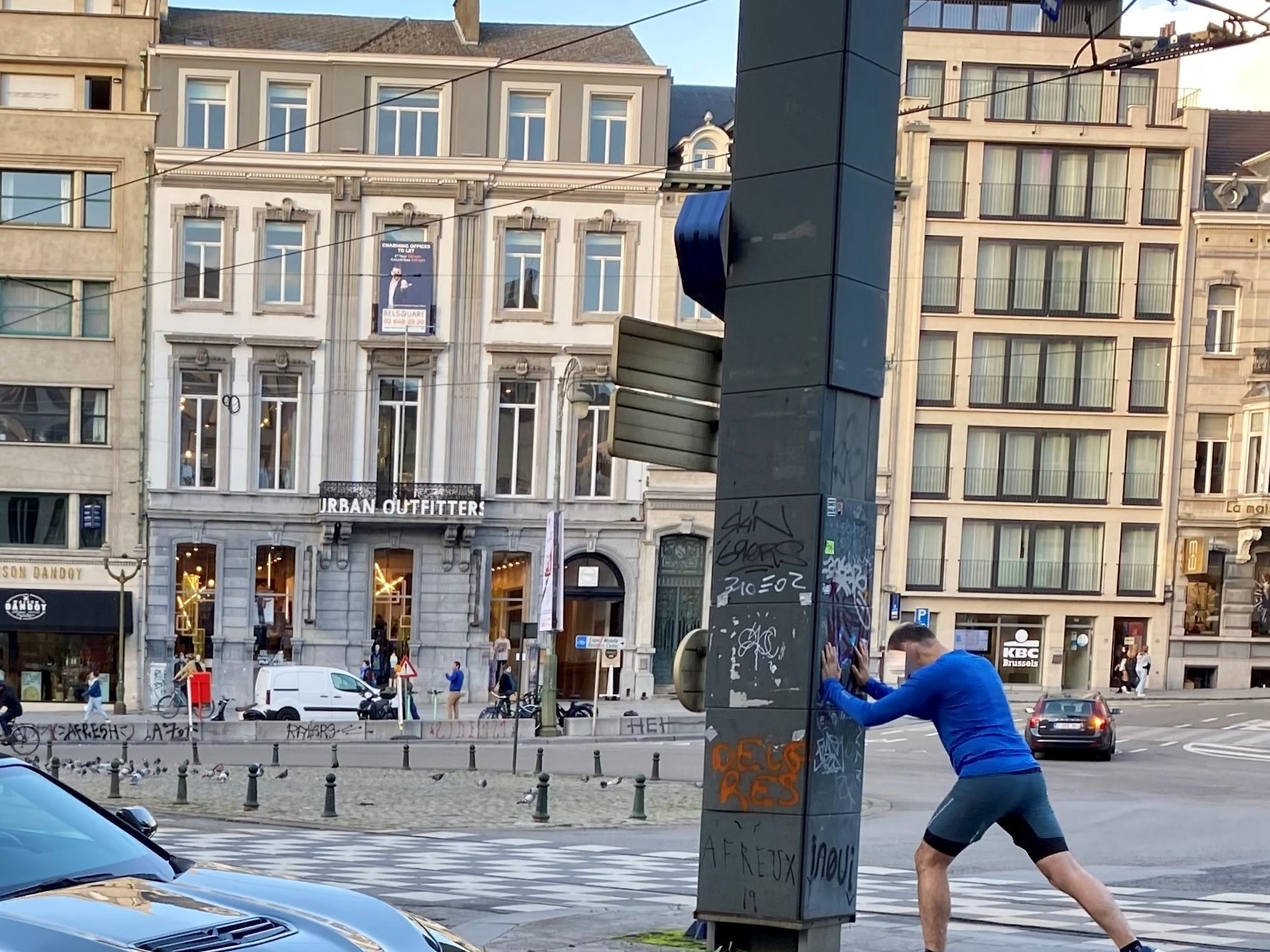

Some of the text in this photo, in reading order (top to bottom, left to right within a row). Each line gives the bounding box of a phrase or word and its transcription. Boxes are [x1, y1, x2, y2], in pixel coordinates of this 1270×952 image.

[382, 499, 484, 516] OUTFITTERS
[1226, 501, 1241, 513] La
[33, 566, 83, 580] DANDOY
[5, 602, 48, 611] DANDOY
[917, 609, 927, 621] P
[1003, 647, 1039, 658] KBC
[1002, 658, 1039, 668] Brussels
